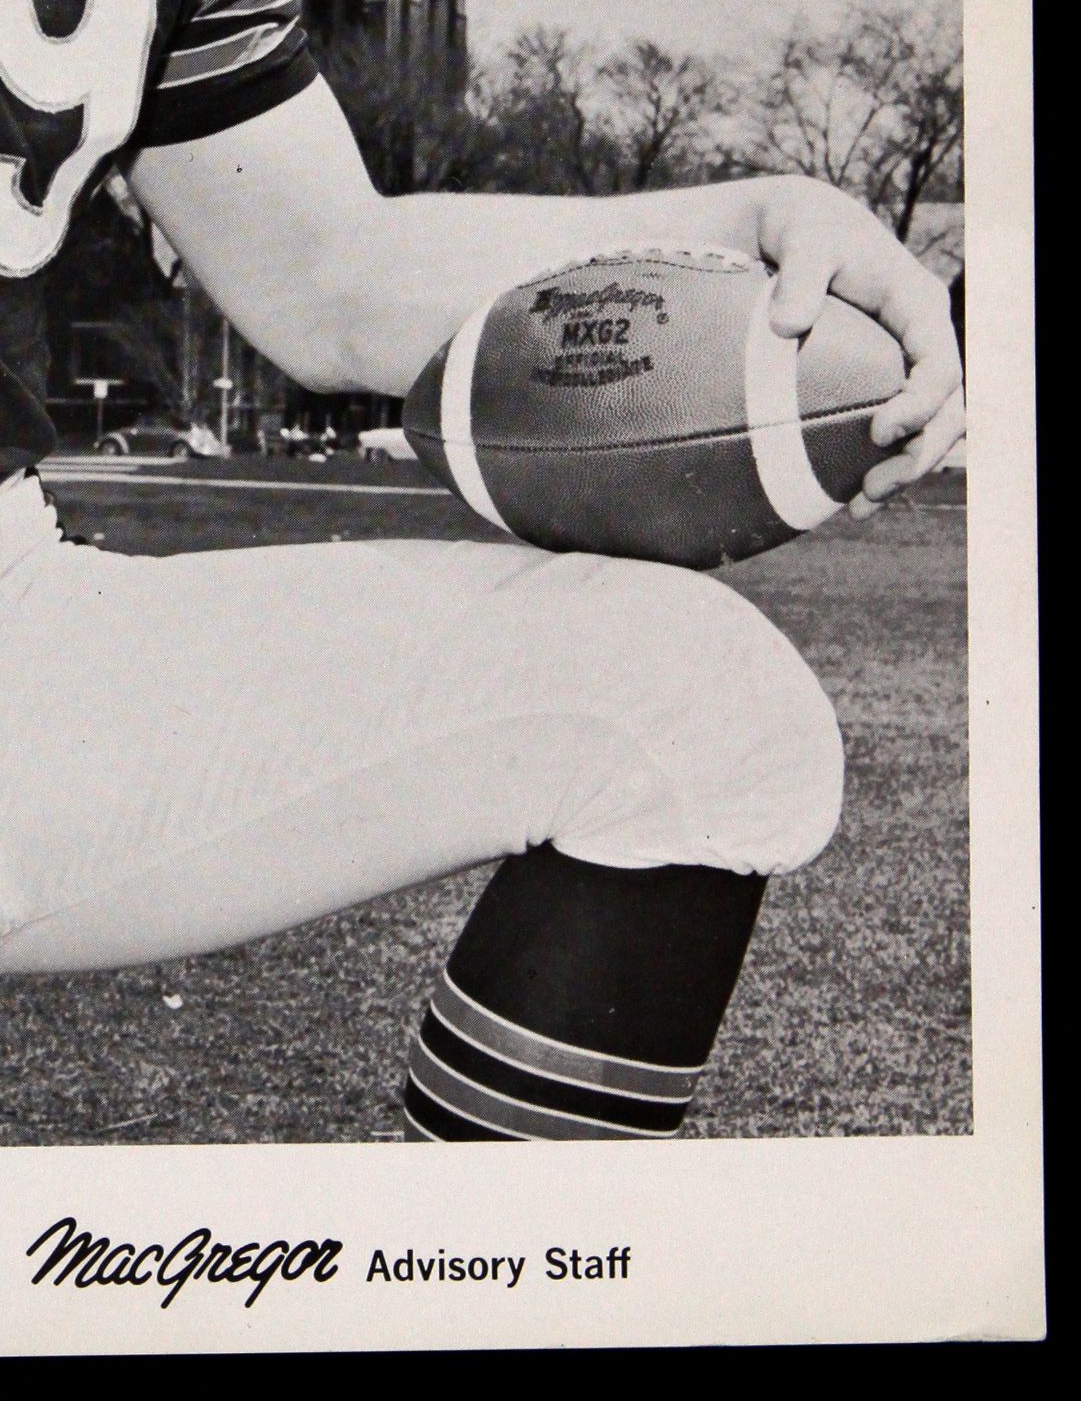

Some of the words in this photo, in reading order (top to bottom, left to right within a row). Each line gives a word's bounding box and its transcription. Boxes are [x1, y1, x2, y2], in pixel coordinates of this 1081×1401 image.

[561, 317, 631, 350] MXG2
[26, 1217, 343, 1309] MacGregor
[366, 1246, 525, 1288] Advisory
[545, 1246, 631, 1280] Staff
